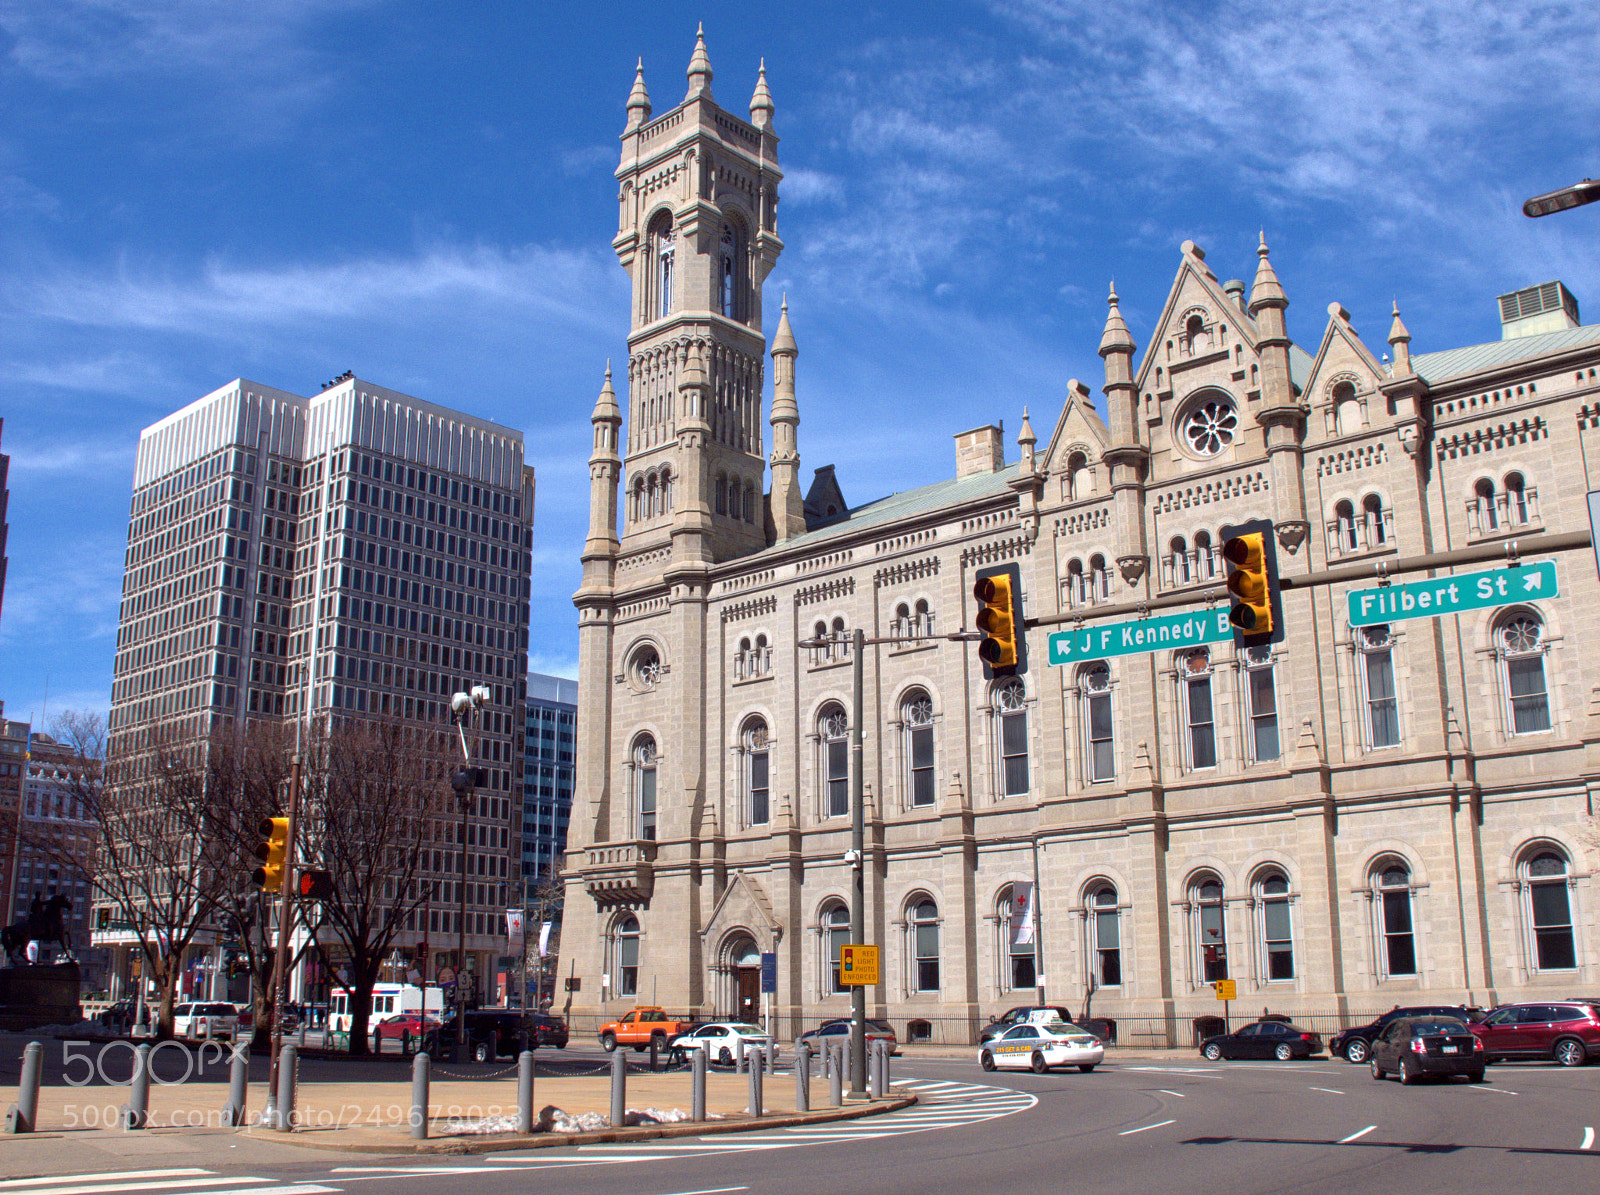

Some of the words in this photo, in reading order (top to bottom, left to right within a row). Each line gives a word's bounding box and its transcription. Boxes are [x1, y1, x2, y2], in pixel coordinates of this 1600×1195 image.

[1361, 583, 1459, 616] Filbert
[1477, 576, 1508, 599] St
[1081, 633, 1091, 653] J
[1101, 630, 1112, 650] F
[1122, 618, 1207, 647] Kennedy
